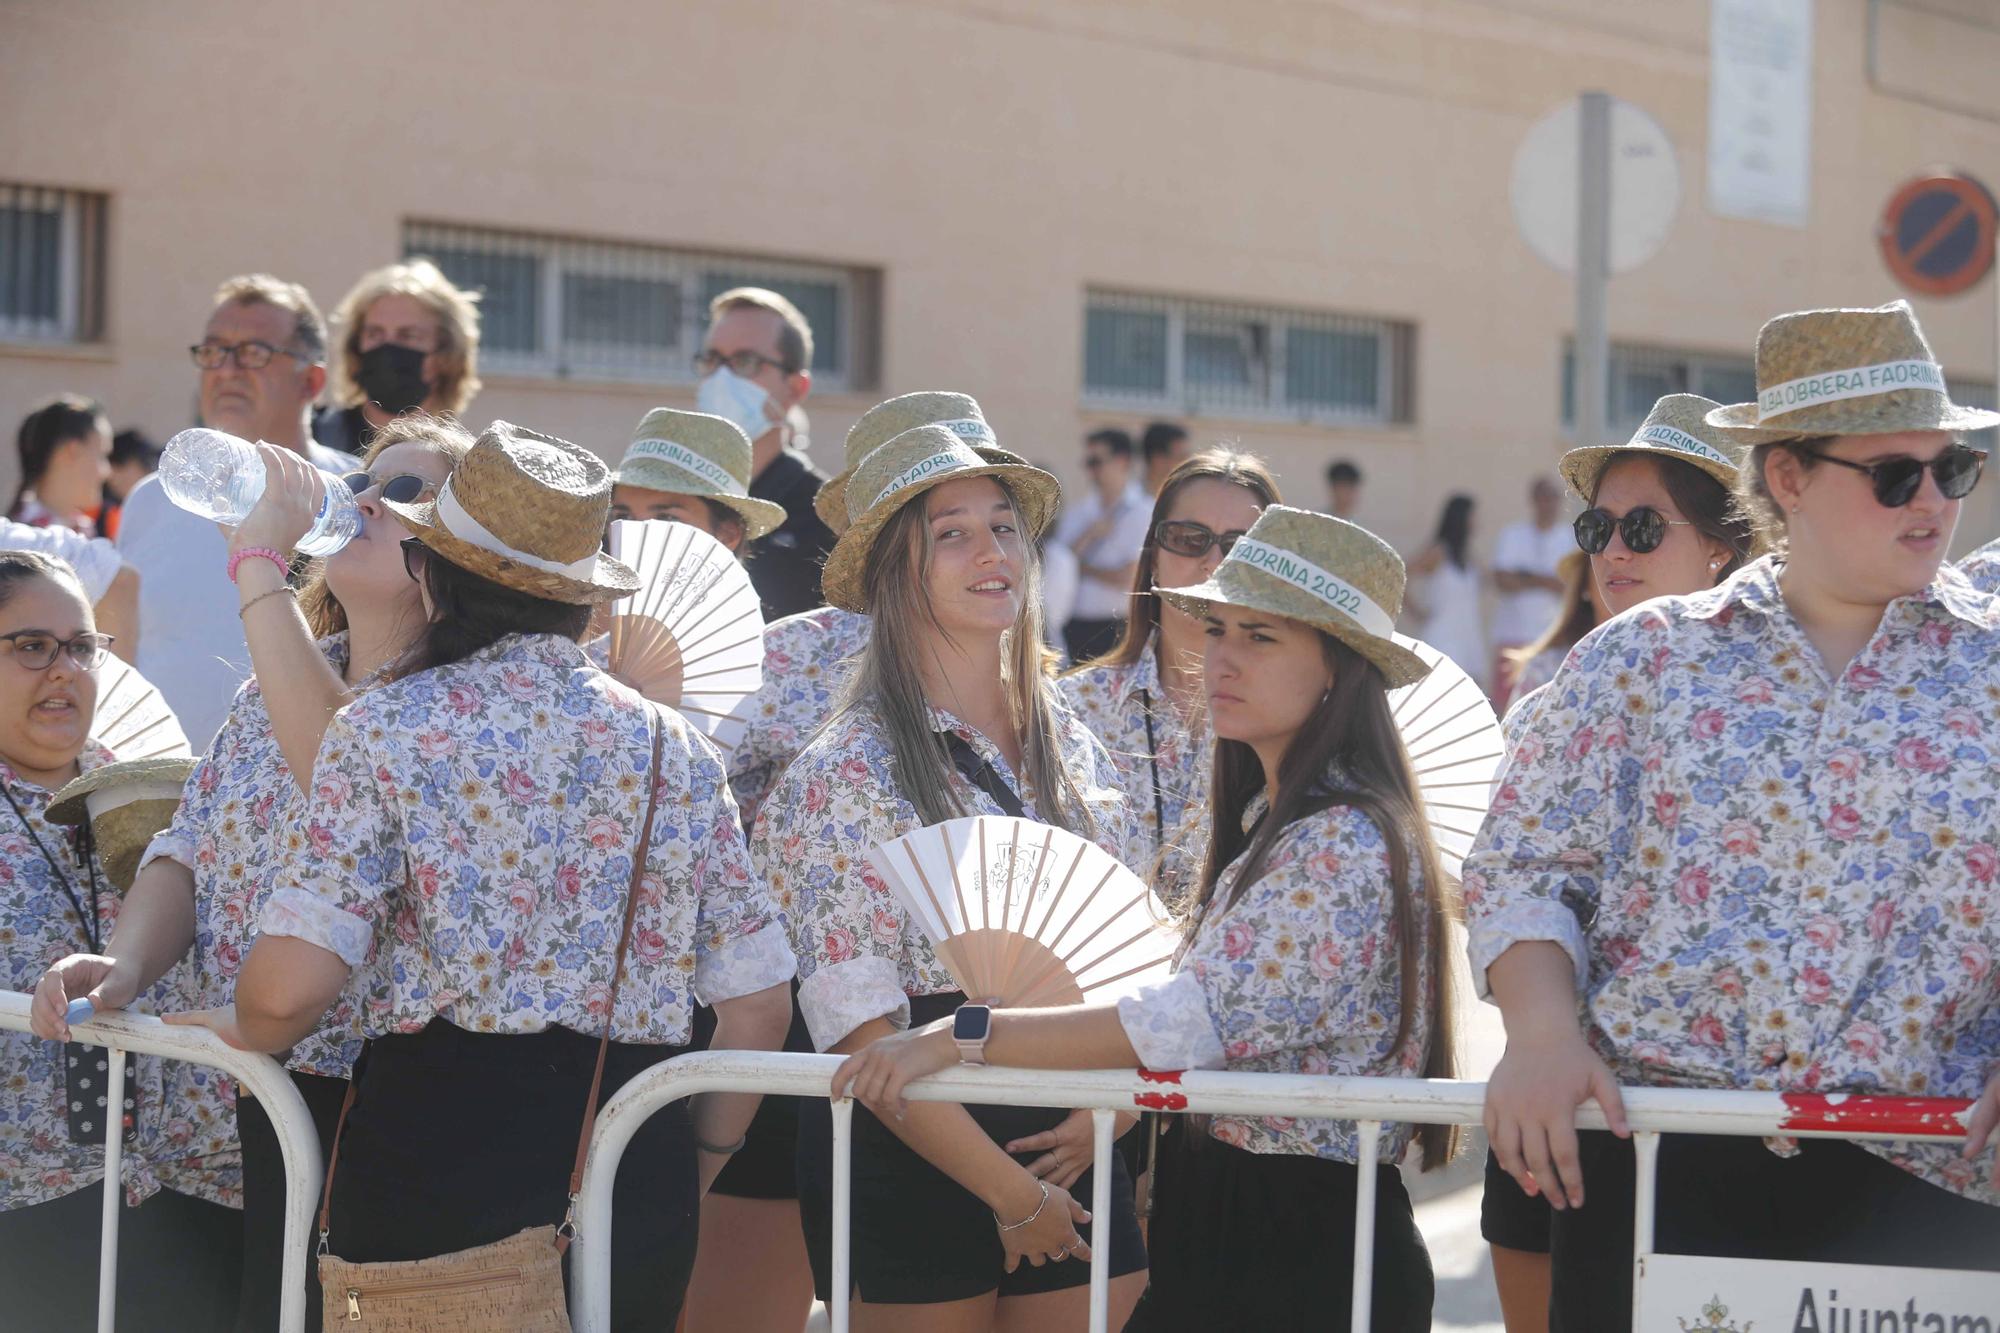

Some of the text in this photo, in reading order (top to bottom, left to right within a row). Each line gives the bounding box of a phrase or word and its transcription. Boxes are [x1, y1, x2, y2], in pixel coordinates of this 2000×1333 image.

[1785, 372, 1864, 405] OBRERA
[695, 458, 729, 489] 2022
[1234, 543, 1361, 615] FADRINA 2022
[1792, 1287, 2000, 1333] Ajuntam
